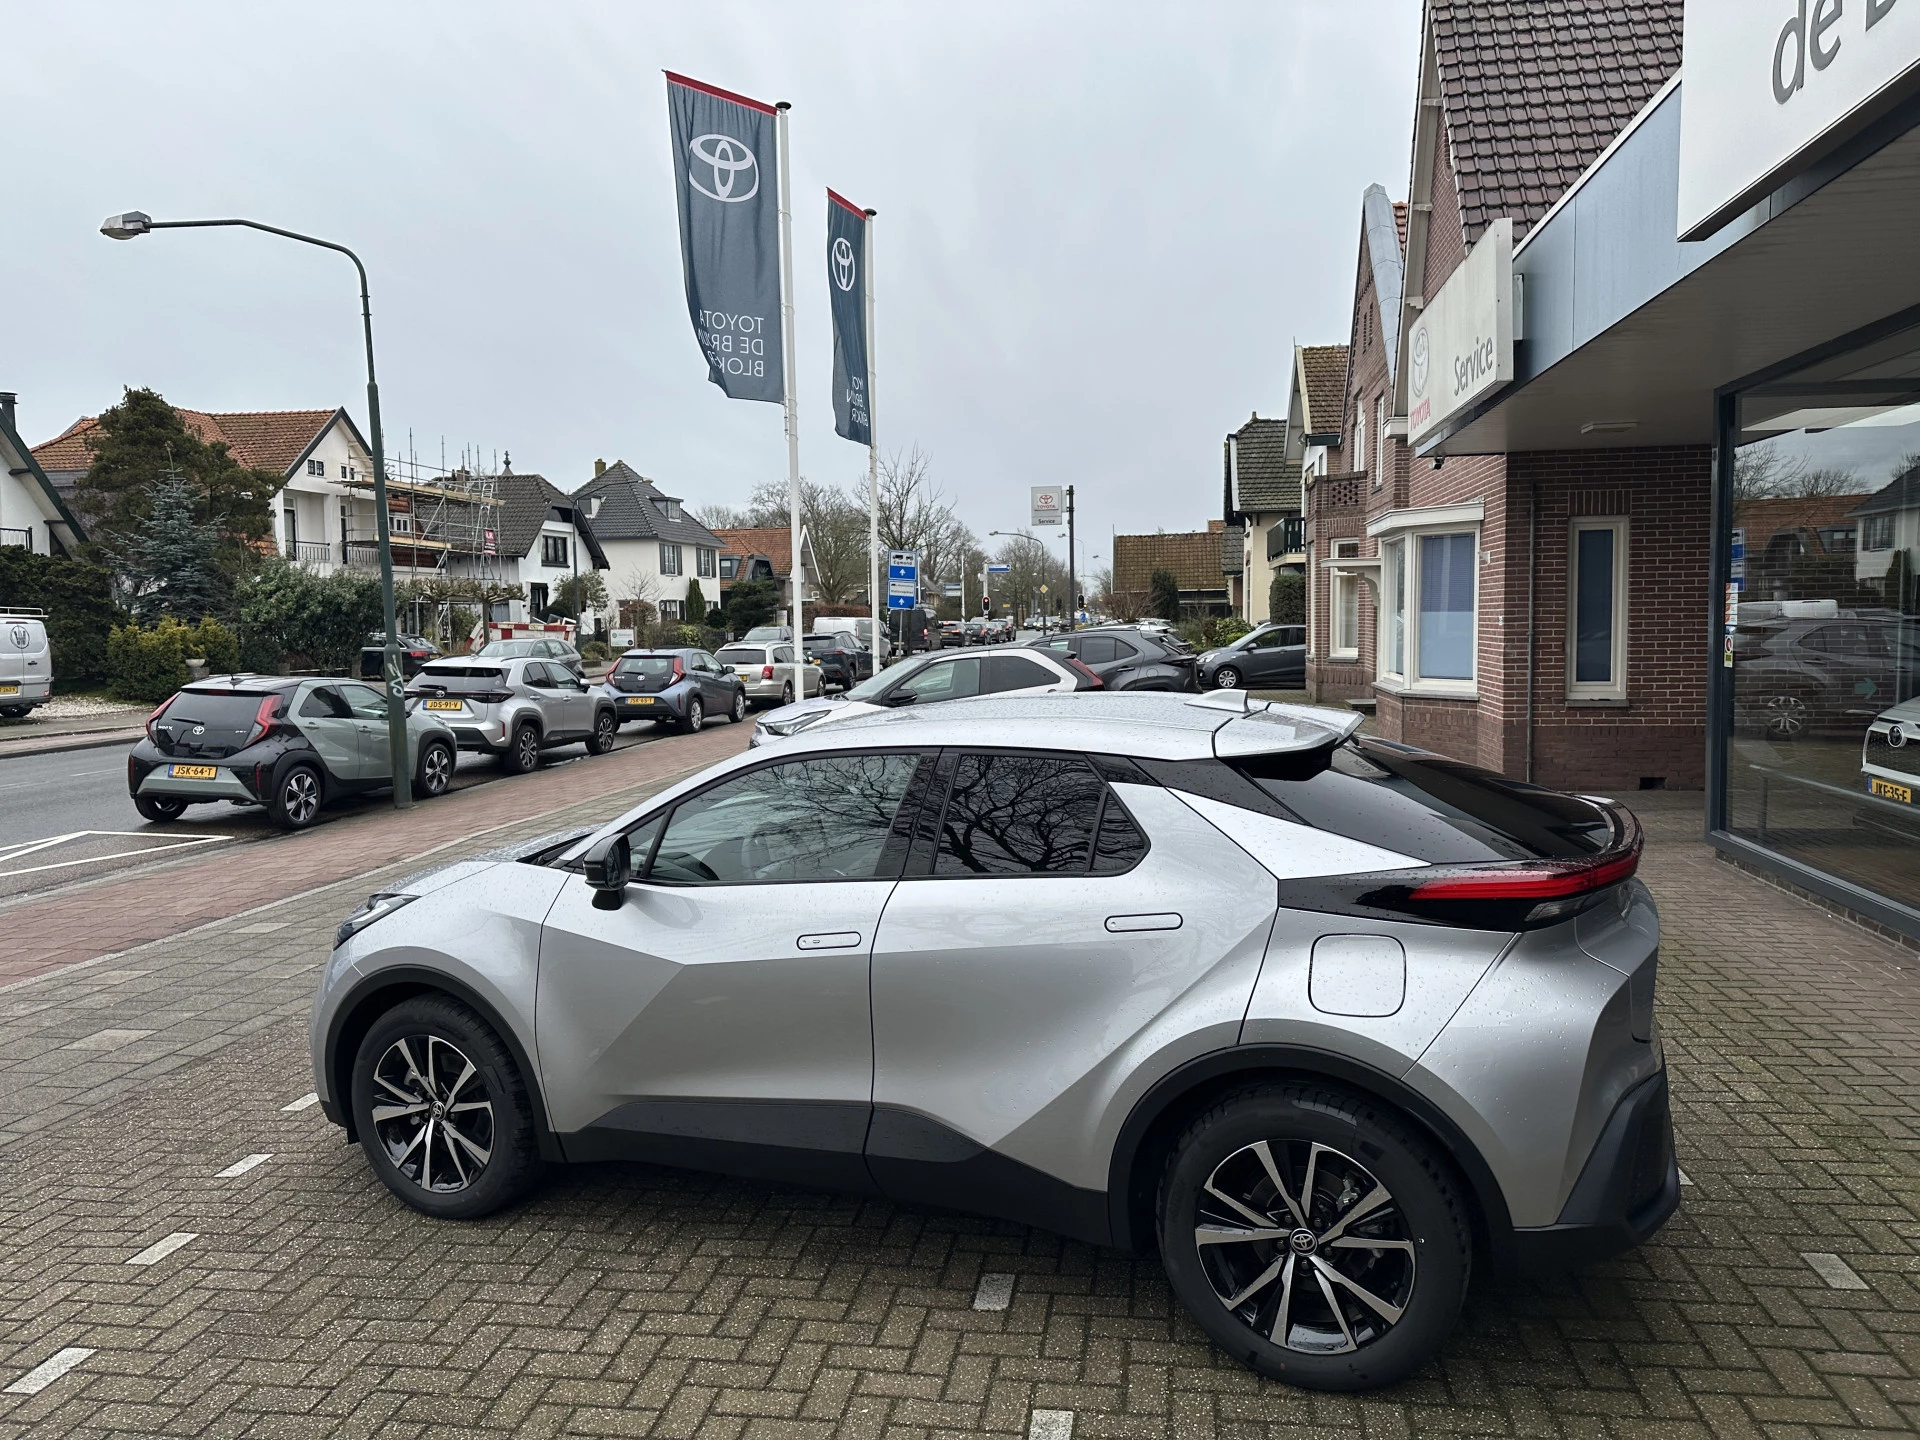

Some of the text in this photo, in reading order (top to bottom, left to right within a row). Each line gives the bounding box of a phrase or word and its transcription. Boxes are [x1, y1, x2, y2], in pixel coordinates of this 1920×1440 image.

[1772, 0, 1843, 105] de
[1453, 336, 1493, 397] Service
[1409, 396, 1431, 432] TOYOTA
[176, 766, 212, 775] JSK-64-T
